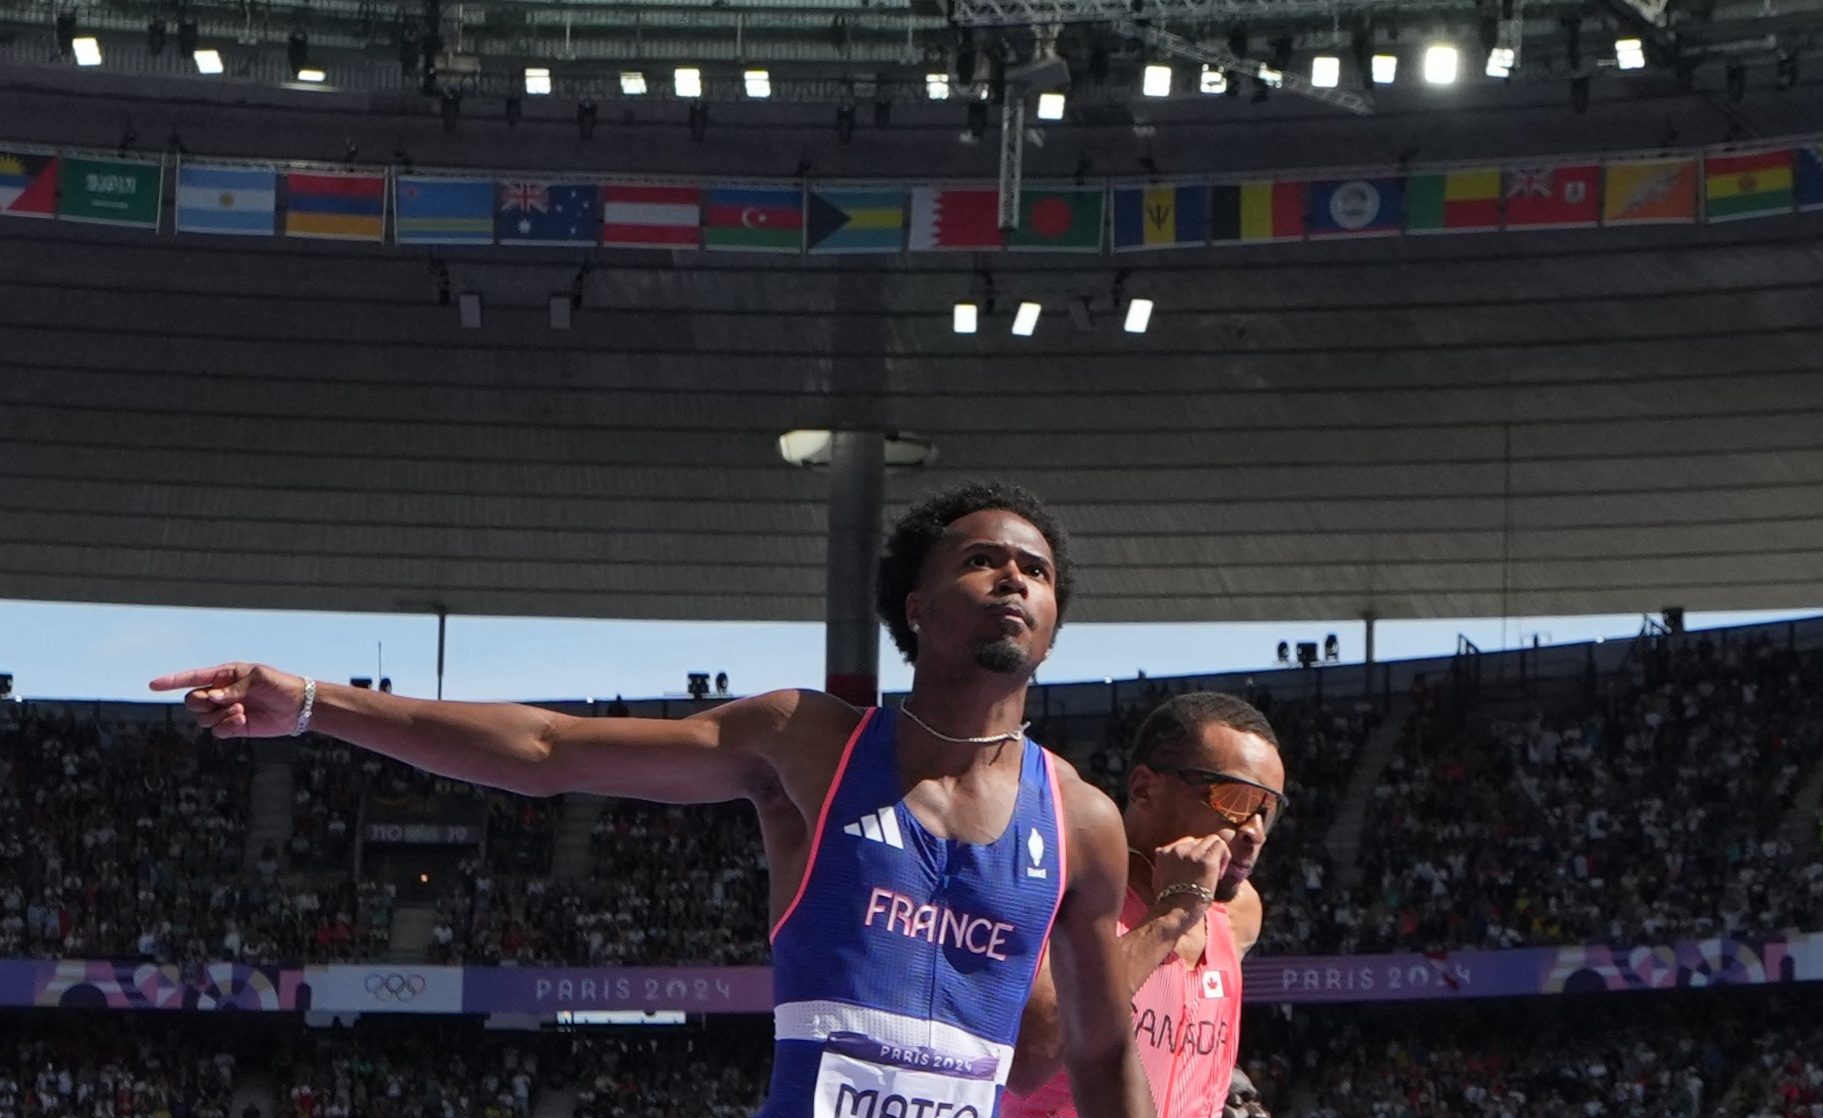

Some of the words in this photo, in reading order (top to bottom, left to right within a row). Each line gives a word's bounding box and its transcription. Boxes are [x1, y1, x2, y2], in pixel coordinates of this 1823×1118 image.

[865, 887, 1014, 961] FRANCE
[535, 977, 630, 1001] PARIS
[645, 977, 731, 1001] 2024
[1282, 966, 1375, 991] PARIS
[1131, 1002, 1228, 1057] ANADA
[879, 1044, 930, 1065] PARIS
[933, 1054, 973, 1073] 2024
